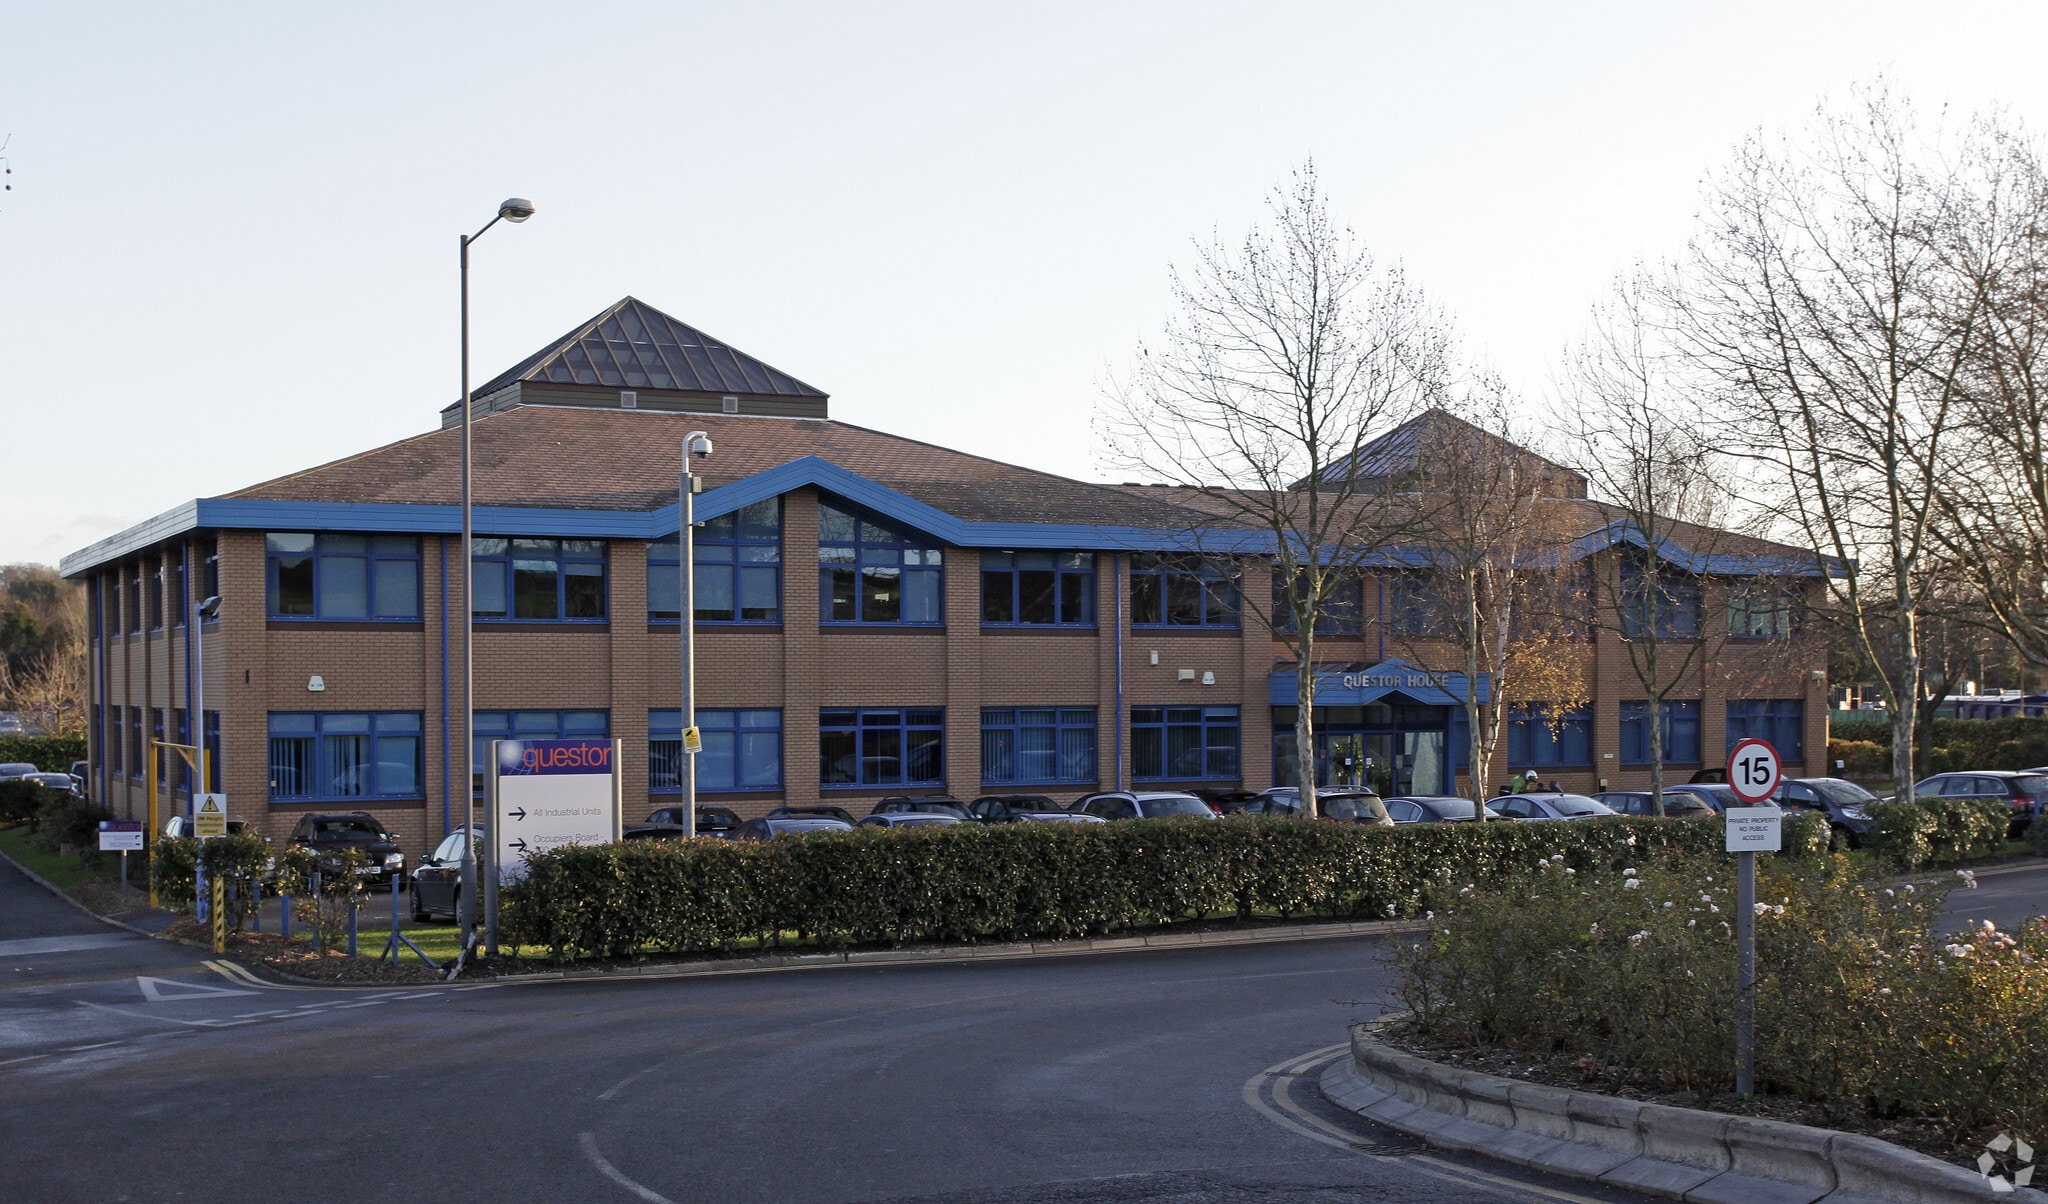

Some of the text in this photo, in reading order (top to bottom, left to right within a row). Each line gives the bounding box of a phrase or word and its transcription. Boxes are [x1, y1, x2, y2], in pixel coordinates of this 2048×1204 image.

[1343, 675, 1448, 689] QUESTOR HOUSE
[523, 742, 612, 773] questor
[1738, 757, 1770, 785] 15
[534, 807, 602, 817] All Industrial Units
[534, 834, 573, 843] Occupiers
[575, 833, 599, 842] Board
